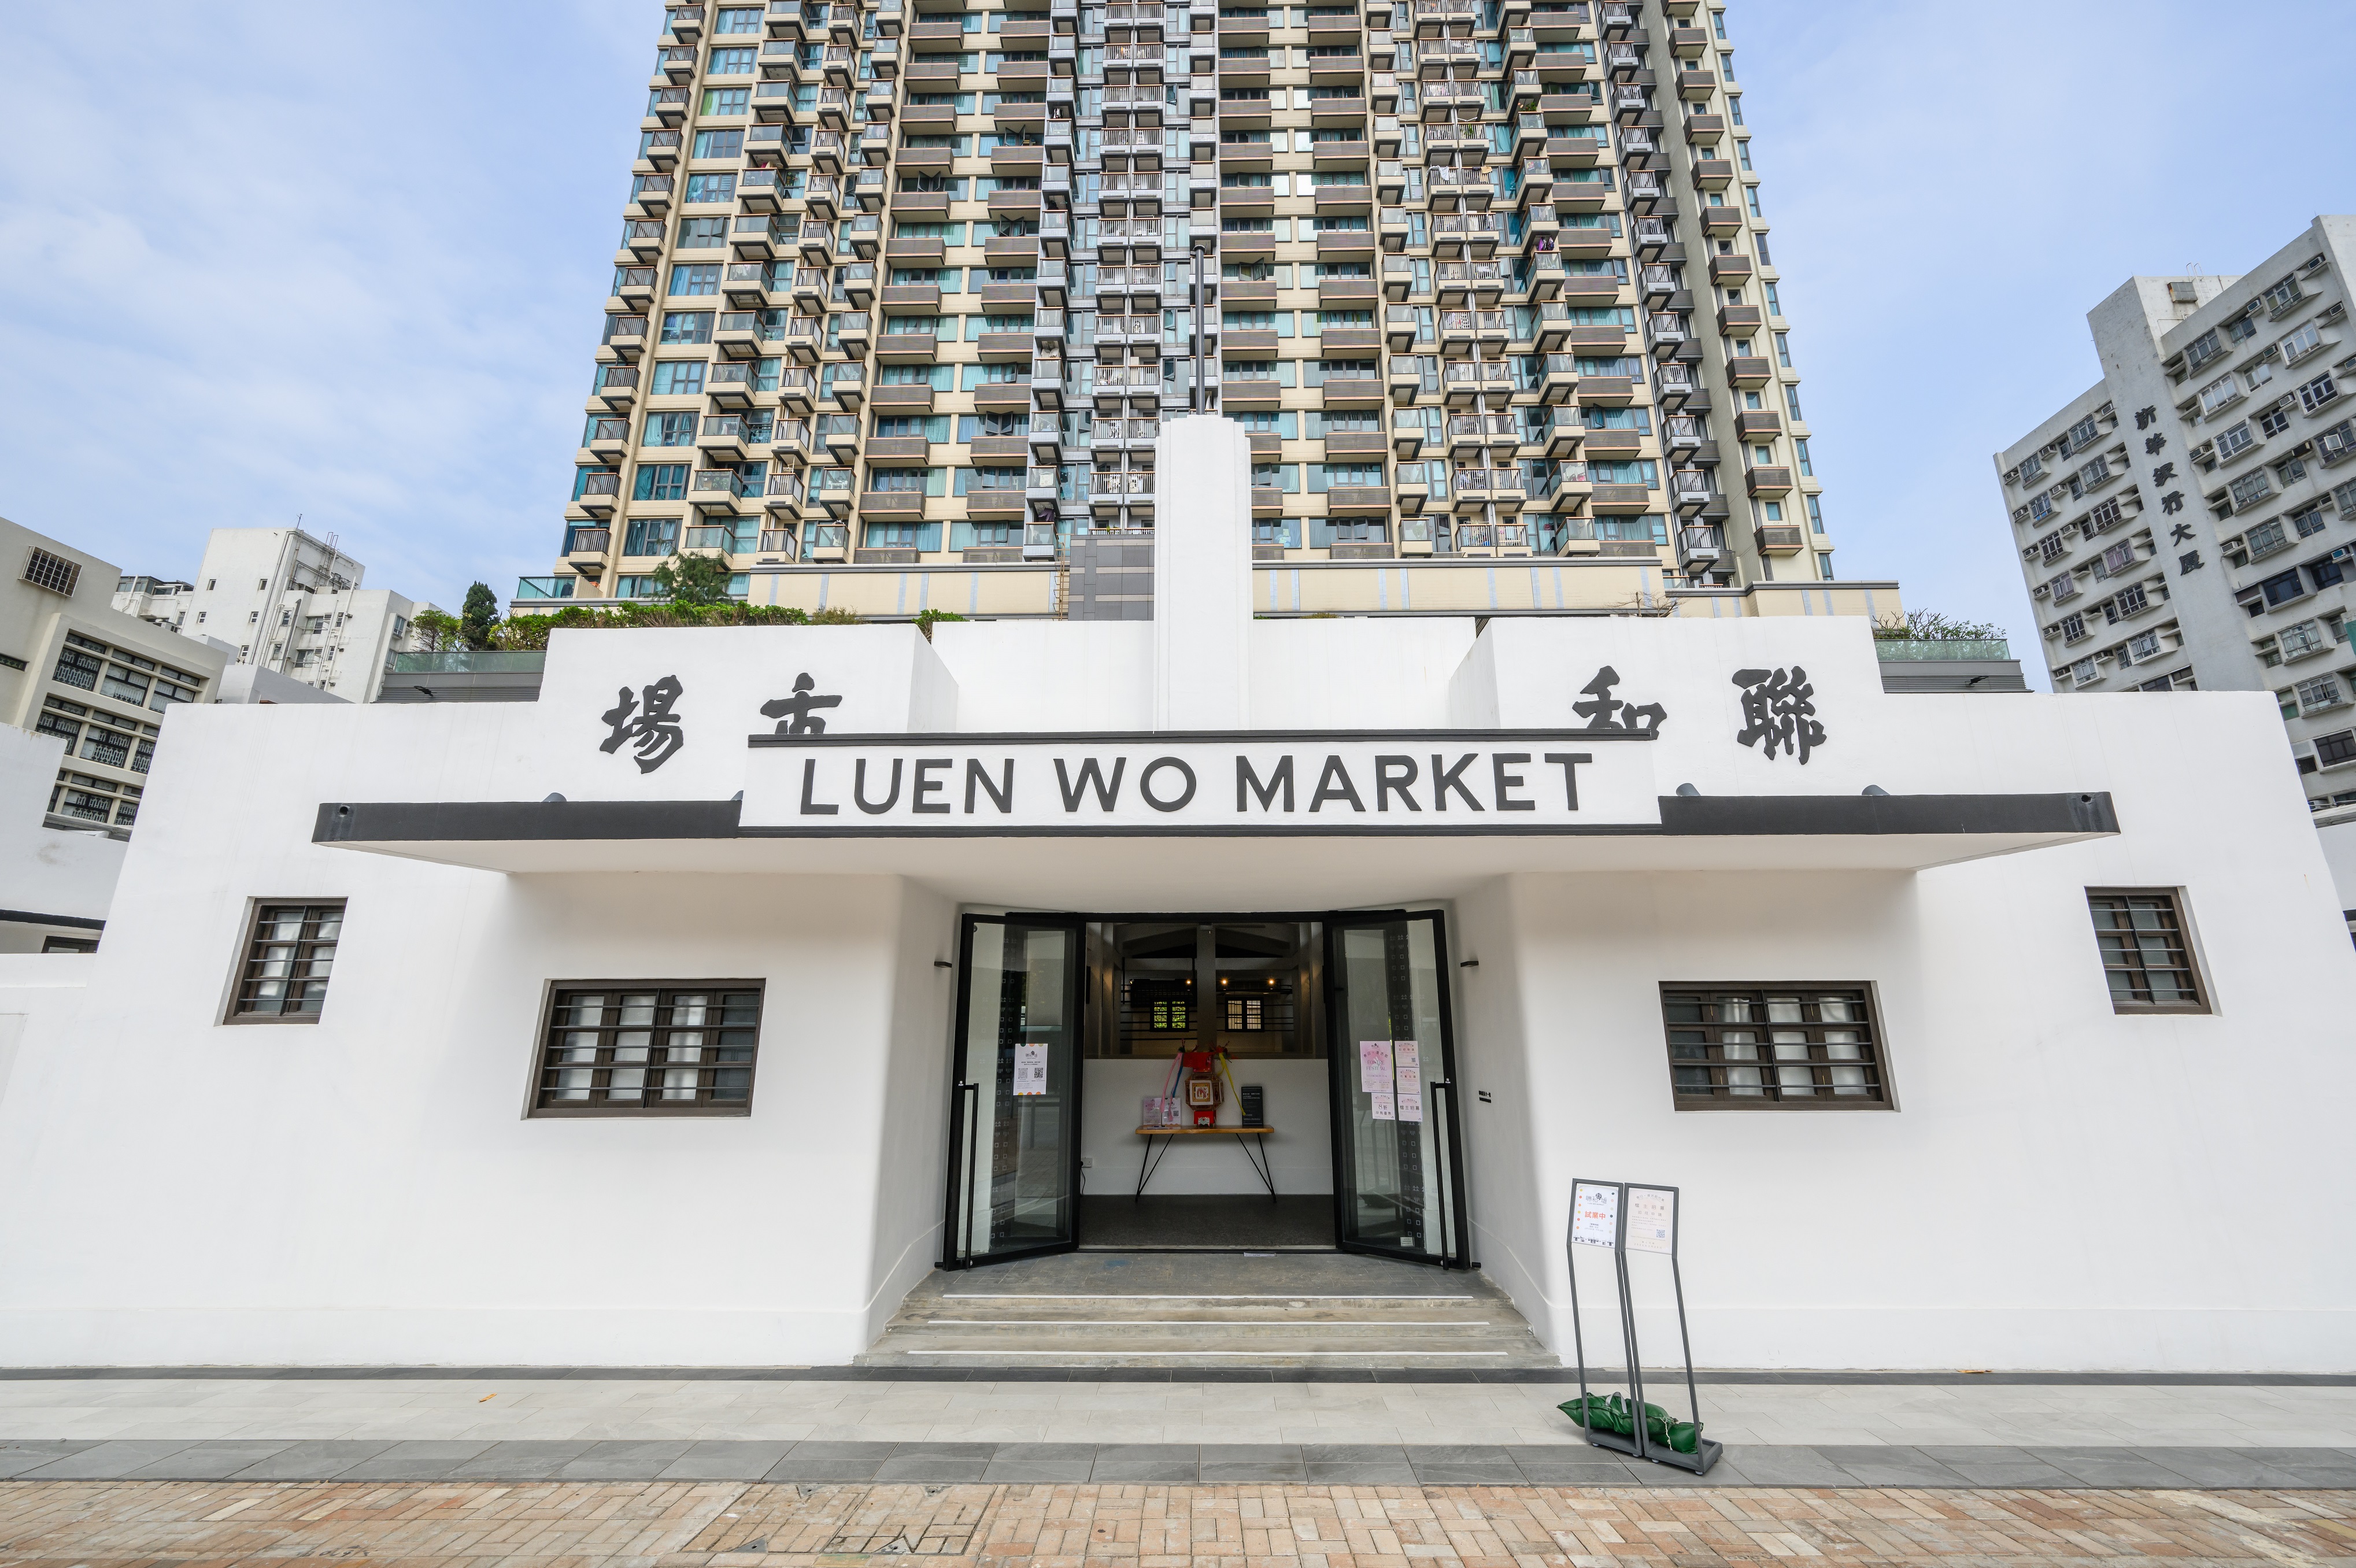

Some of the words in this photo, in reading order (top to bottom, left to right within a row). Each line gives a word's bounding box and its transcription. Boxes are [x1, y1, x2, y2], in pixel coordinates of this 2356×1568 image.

[800, 758, 1014, 814] LUEN
[1053, 756, 1197, 812] WO
[1236, 753, 1592, 812] MARKET
[1585, 1211, 1606, 1220] 試業中
